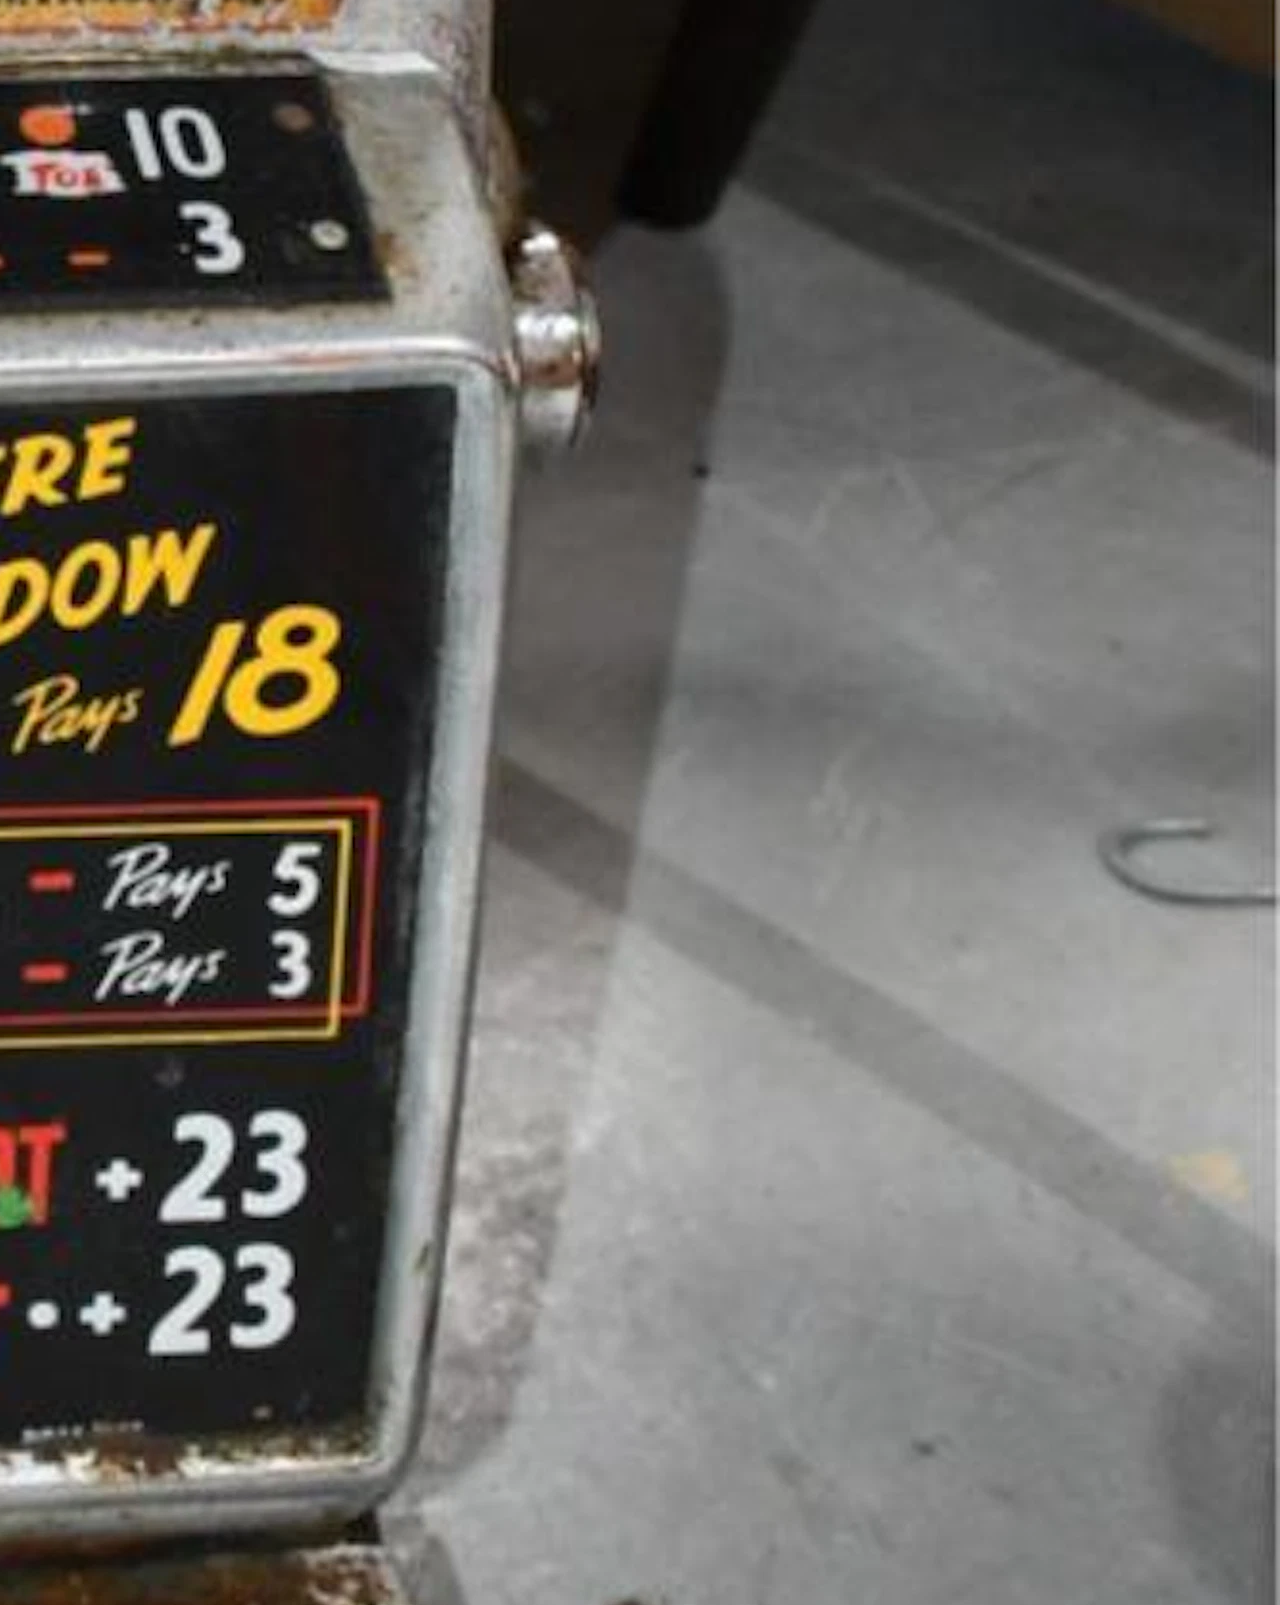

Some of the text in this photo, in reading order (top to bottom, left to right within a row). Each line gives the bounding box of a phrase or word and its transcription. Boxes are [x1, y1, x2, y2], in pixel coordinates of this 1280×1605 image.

[124, 106, 227, 180] 10
[180, 201, 243, 274] 3
[11, 603, 342, 755] Pays 18
[101, 843, 232, 920] Pays
[269, 842, 322, 918] 5
[95, 930, 226, 1006] Pays
[269, 930, 311, 998] 3
